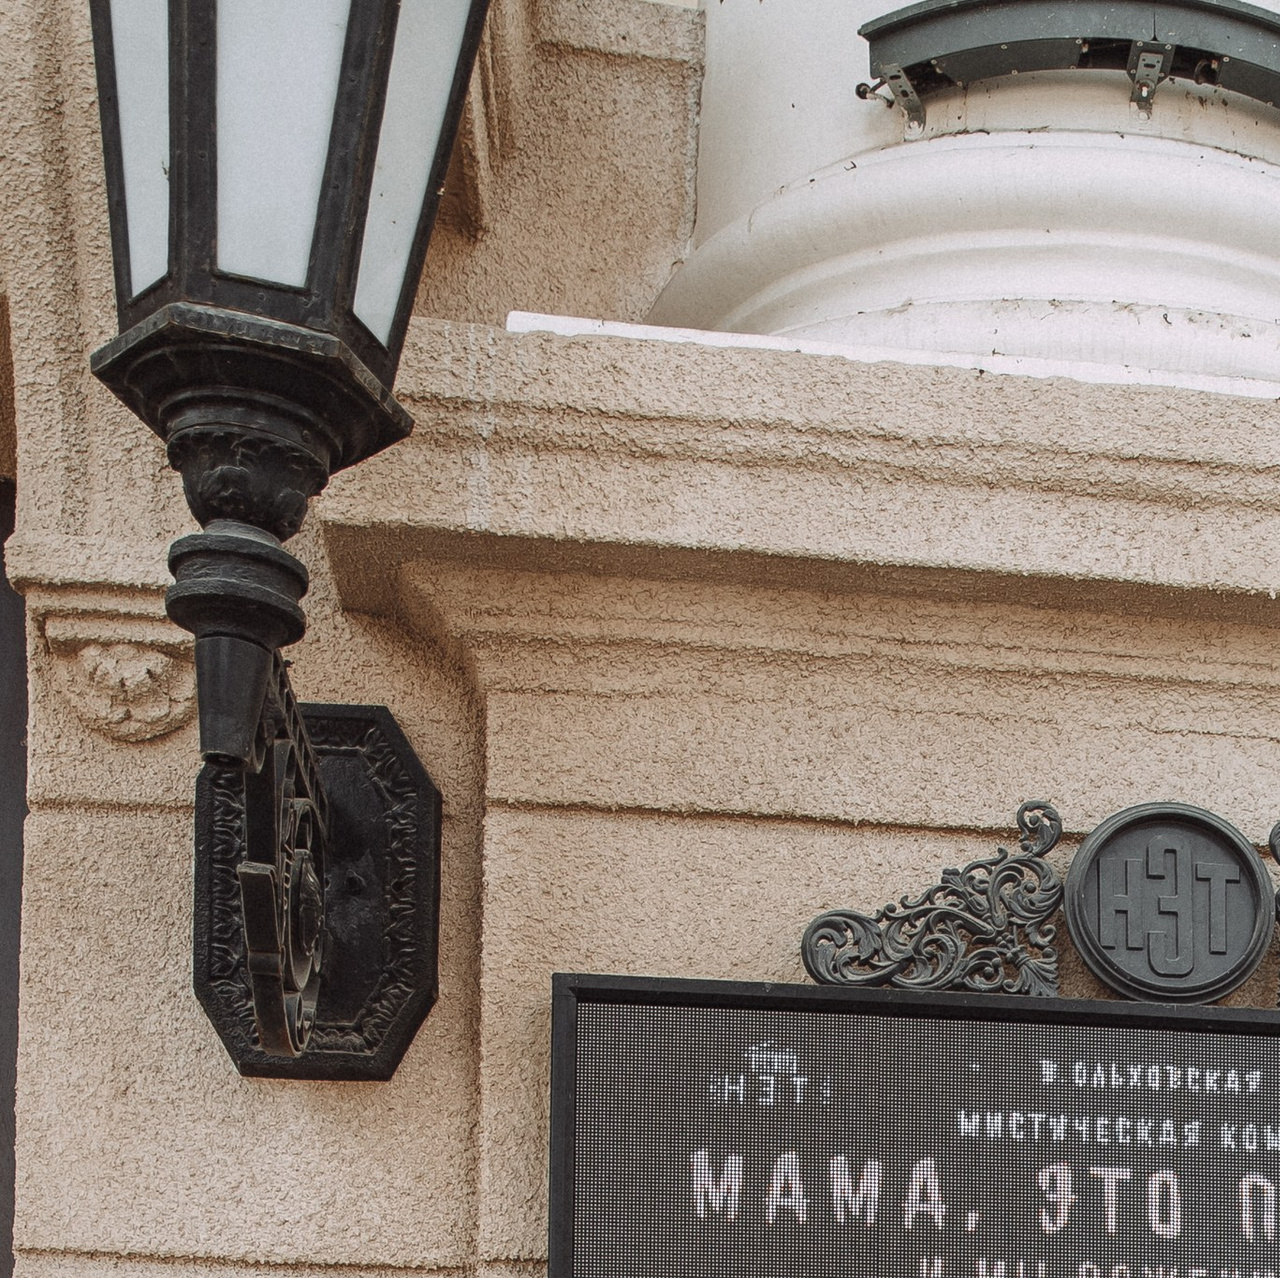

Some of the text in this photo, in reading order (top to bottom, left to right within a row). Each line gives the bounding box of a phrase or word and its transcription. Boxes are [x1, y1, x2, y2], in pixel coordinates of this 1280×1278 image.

[1097, 834, 1241, 979] НЭТ
[957, 1109, 1202, 1147] МИСТИЧЕСКАЯ
[690, 1150, 980, 1233] МАМА,
[1037, 1161, 1182, 1239] ЭТО
